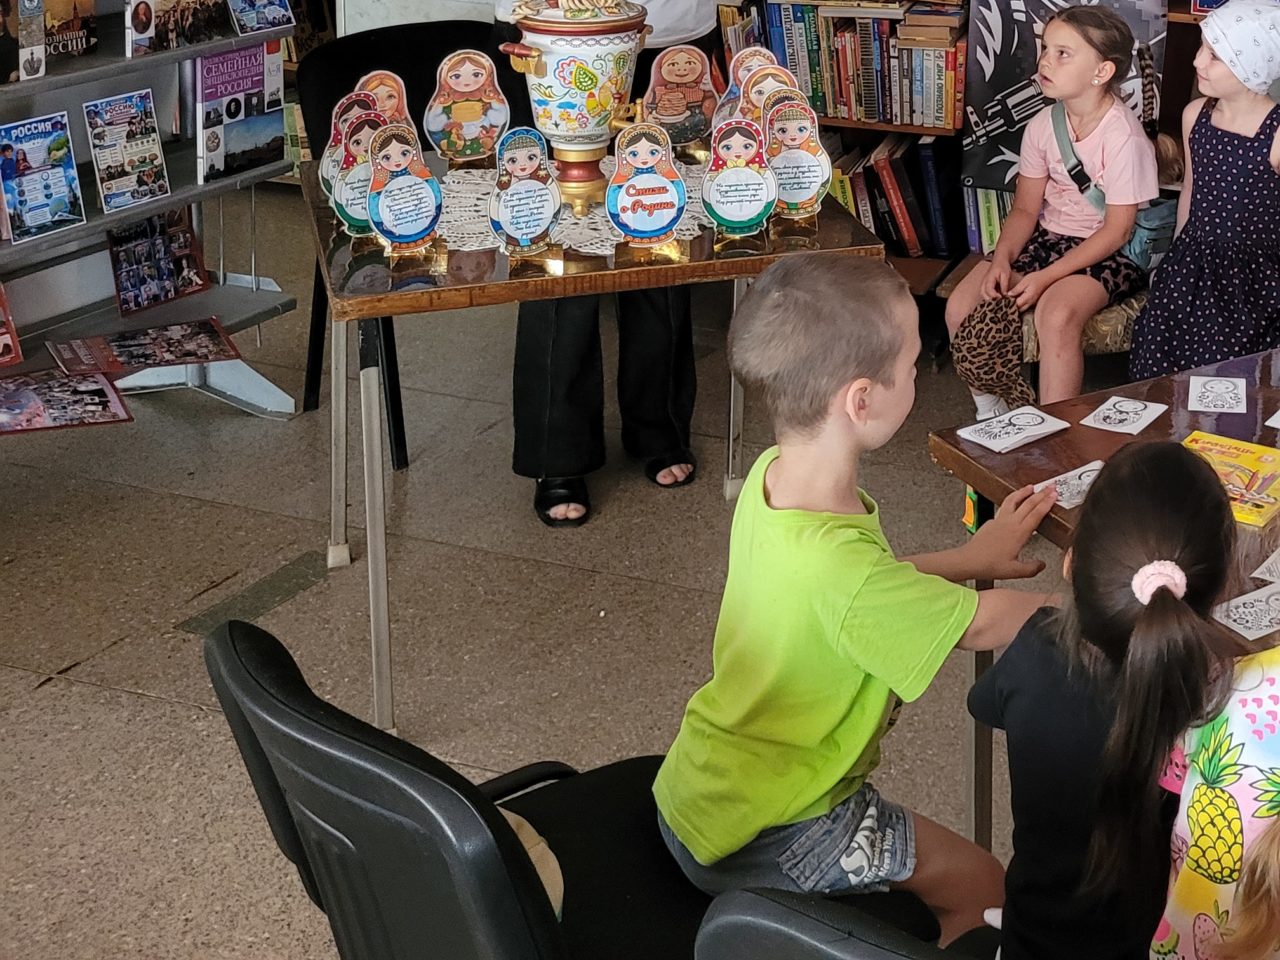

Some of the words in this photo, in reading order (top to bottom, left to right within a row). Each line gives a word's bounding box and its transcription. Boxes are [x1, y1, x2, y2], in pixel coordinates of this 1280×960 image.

[204, 52, 263, 78] СЕМЕЙНАЯ
[218, 78, 252, 96] РОССИЯ
[103, 102, 135, 116] РОССИЮ
[10, 121, 53, 140] РОССИЯ
[625, 184, 670, 198] Стихи
[621, 205, 629, 215] о
[628, 198, 678, 217] Родине
